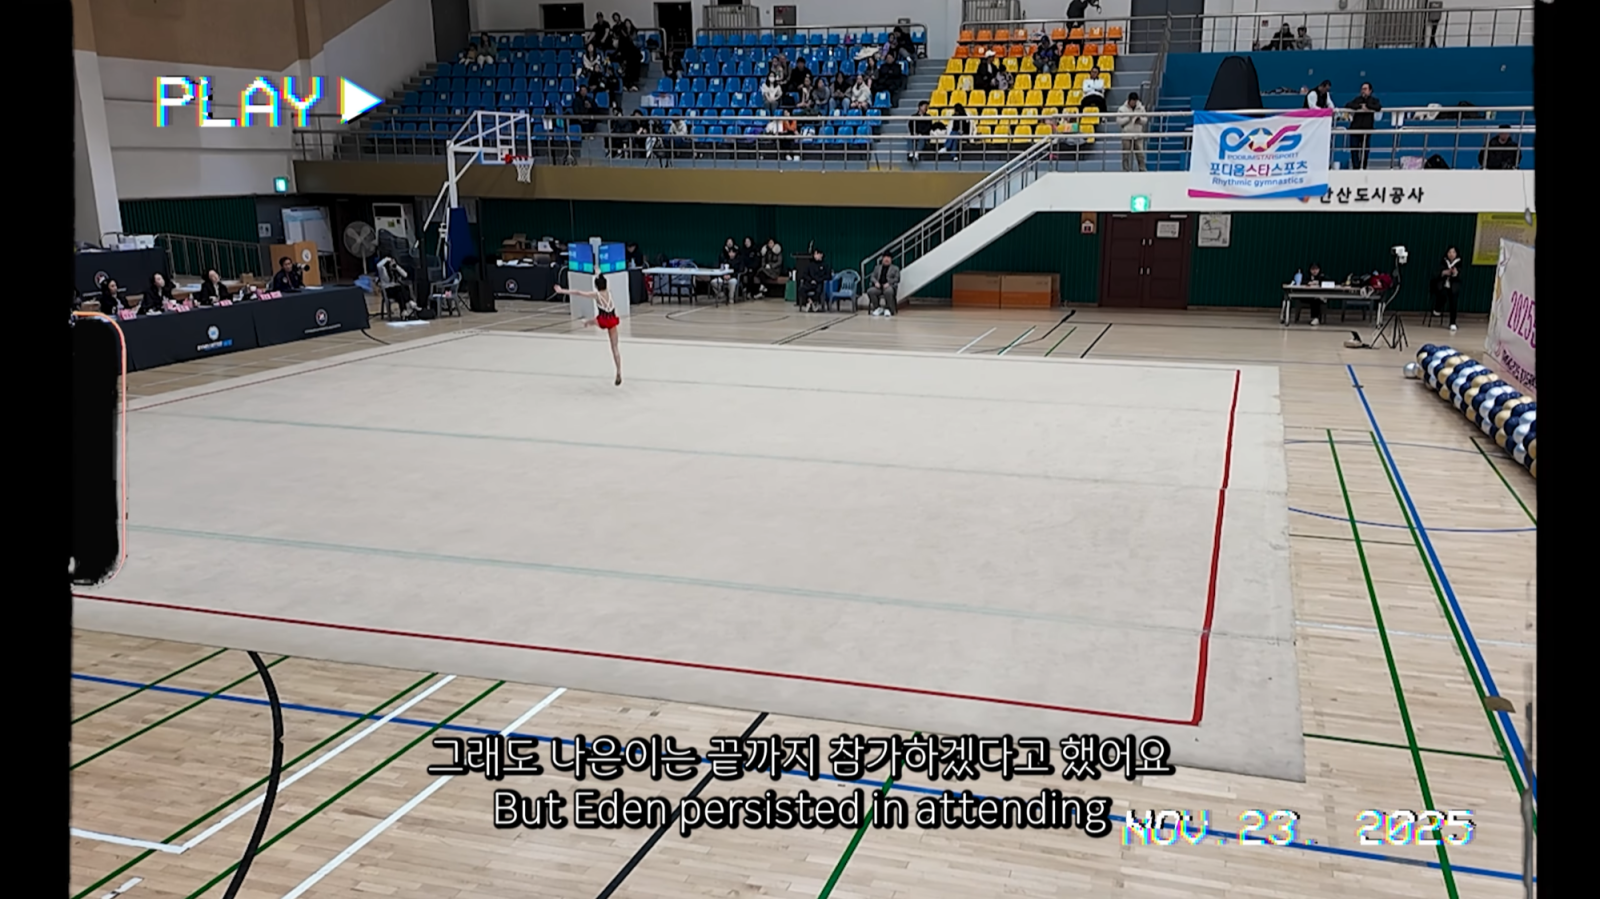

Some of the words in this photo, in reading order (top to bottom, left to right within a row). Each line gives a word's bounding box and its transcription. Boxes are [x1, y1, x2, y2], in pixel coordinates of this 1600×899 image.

[1209, 161, 1308, 177] 포디움스타스포츠
[1212, 175, 1251, 187] Rhythmic
[1254, 175, 1304, 187] gymnastics
[1507, 290, 1536, 349] 2025
